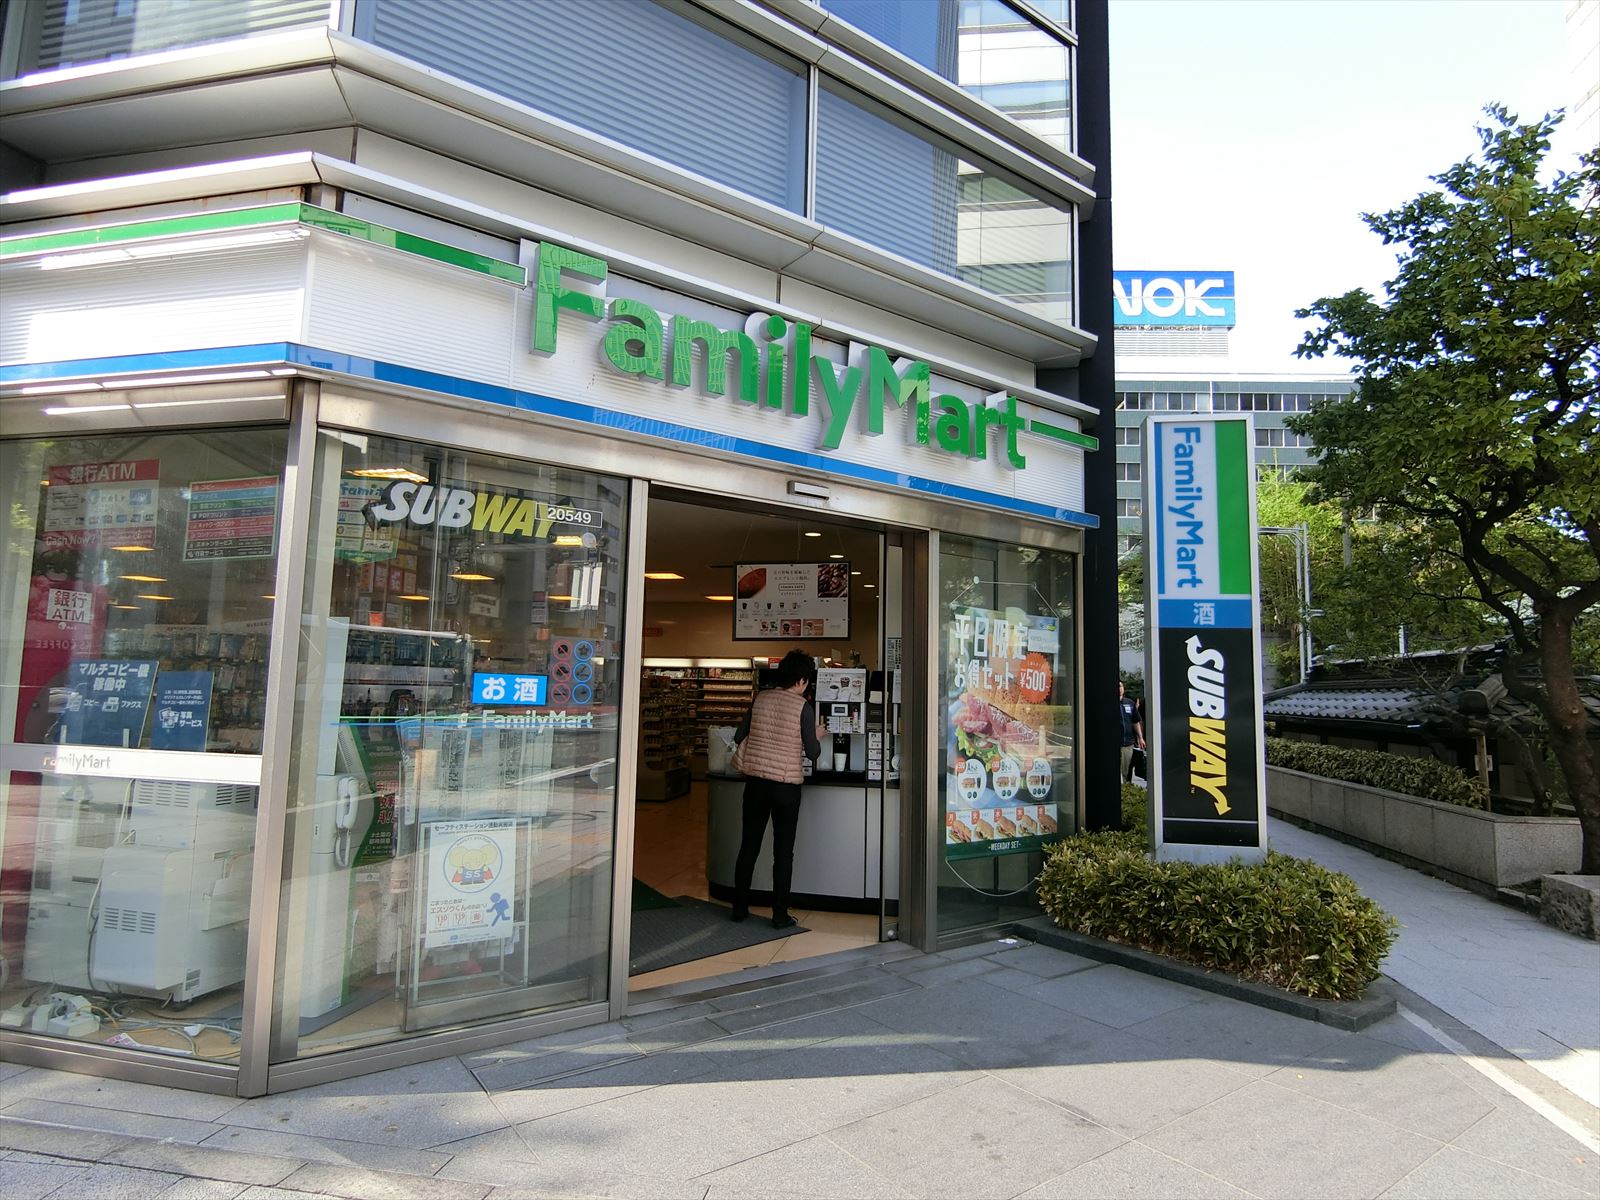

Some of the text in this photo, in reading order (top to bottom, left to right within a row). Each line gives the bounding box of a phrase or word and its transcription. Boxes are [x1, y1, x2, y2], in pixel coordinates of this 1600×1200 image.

[1113, 277, 1225, 317] NOK
[532, 240, 1027, 471] FamilyMart
[69, 462, 137, 483] 銀行ATM
[372, 482, 577, 539] SUBWAY
[547, 507, 592, 525] 20549
[1168, 427, 1205, 588] FamilyMart
[54, 590, 88, 608] 銀行
[52, 608, 86, 621] ATM
[1193, 602, 1215, 626] 酒
[954, 658, 1014, 690] お得セット
[481, 677, 539, 703] お酒
[482, 709, 594, 734] FamilyMart
[1184, 635, 1233, 816] SUBWAY
[465, 870, 481, 879] SS
